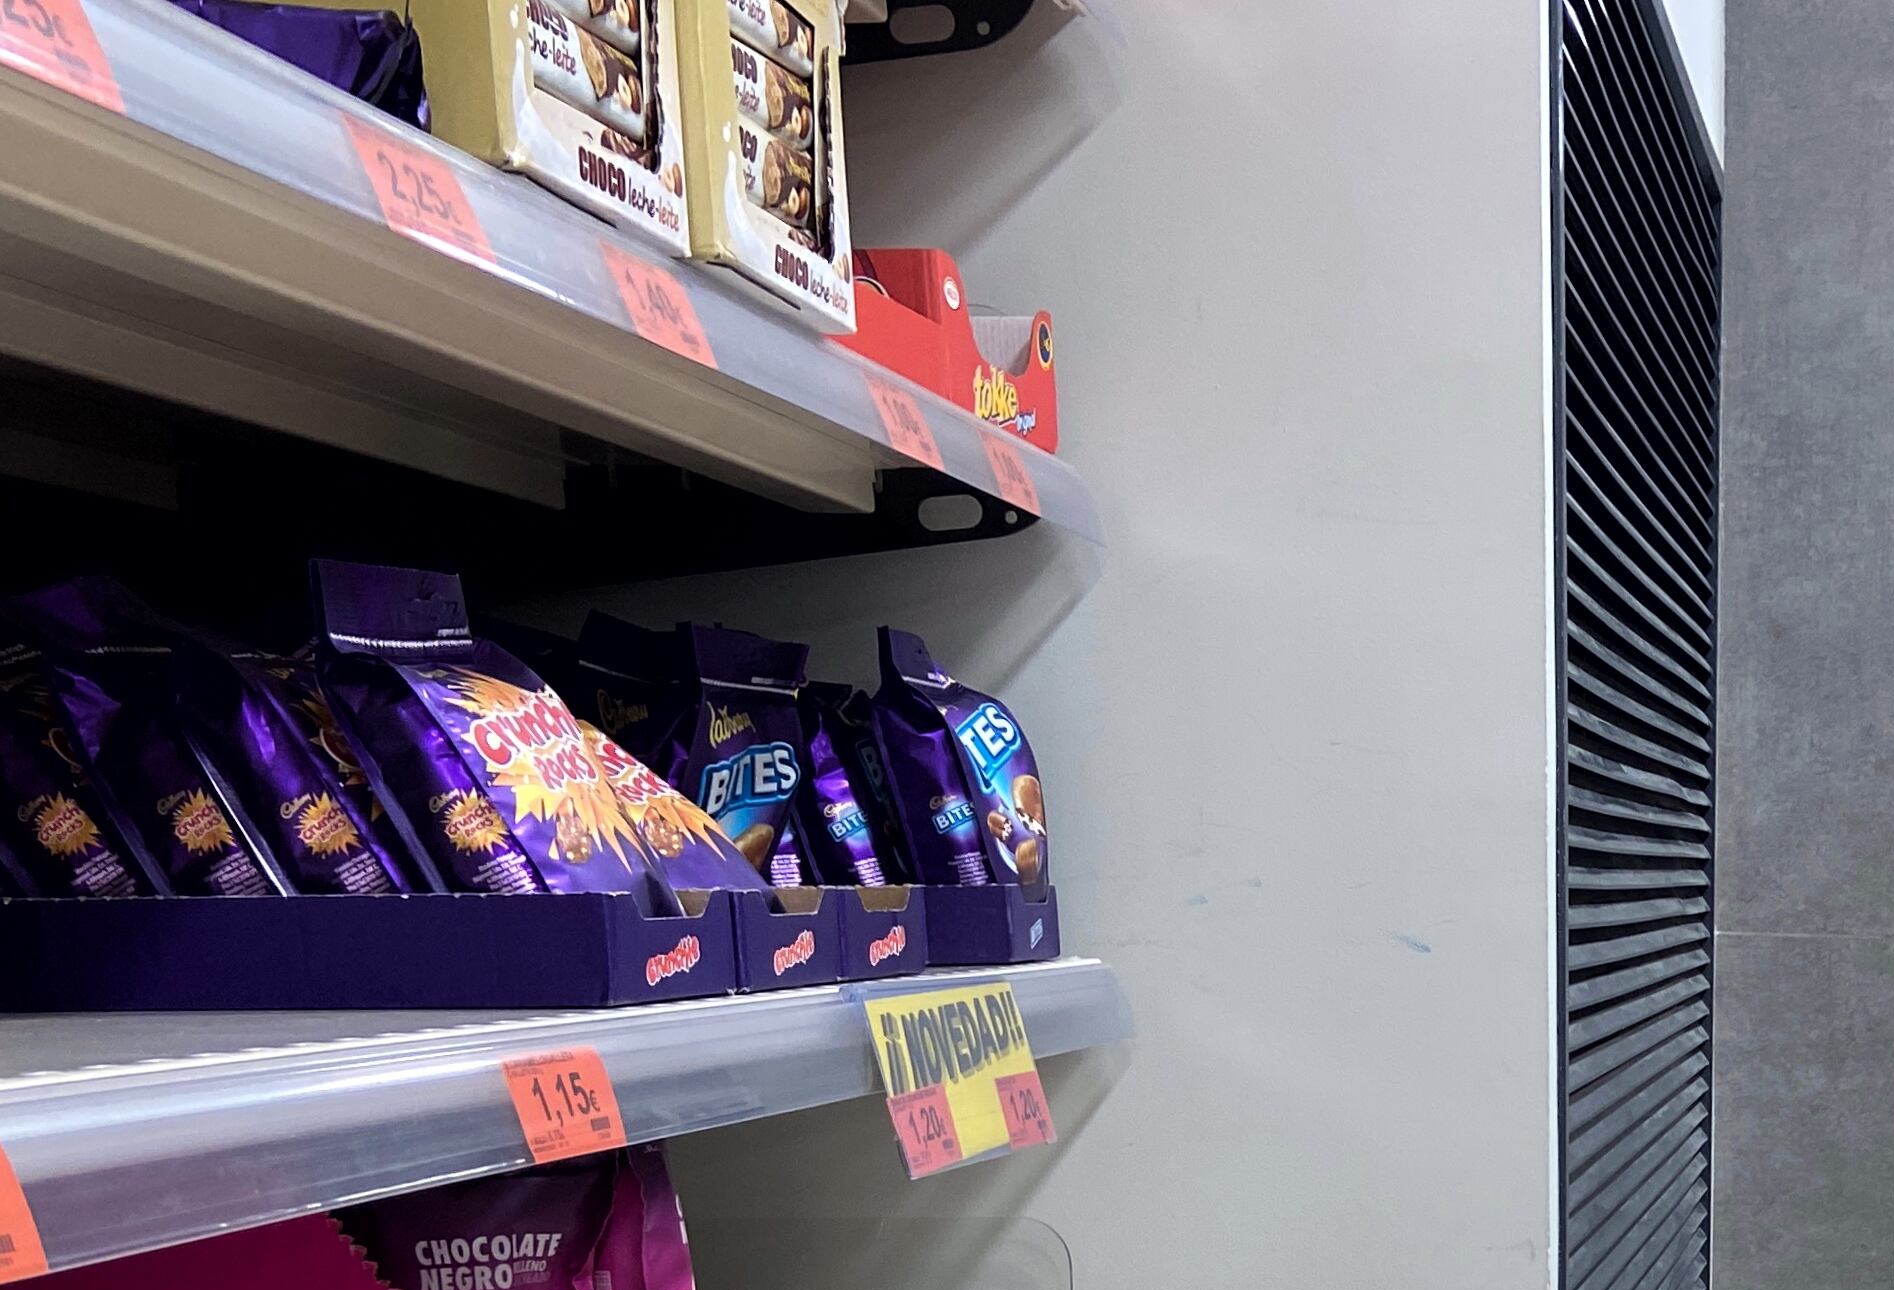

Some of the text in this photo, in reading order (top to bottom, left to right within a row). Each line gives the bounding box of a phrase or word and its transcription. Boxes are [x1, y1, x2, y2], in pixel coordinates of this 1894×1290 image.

[579, 146, 626, 202] CHOCO
[706, 749, 797, 815] BITES
[532, 1071, 601, 1128] 1,15€
[415, 1233, 562, 1267] CHOCOLATE
